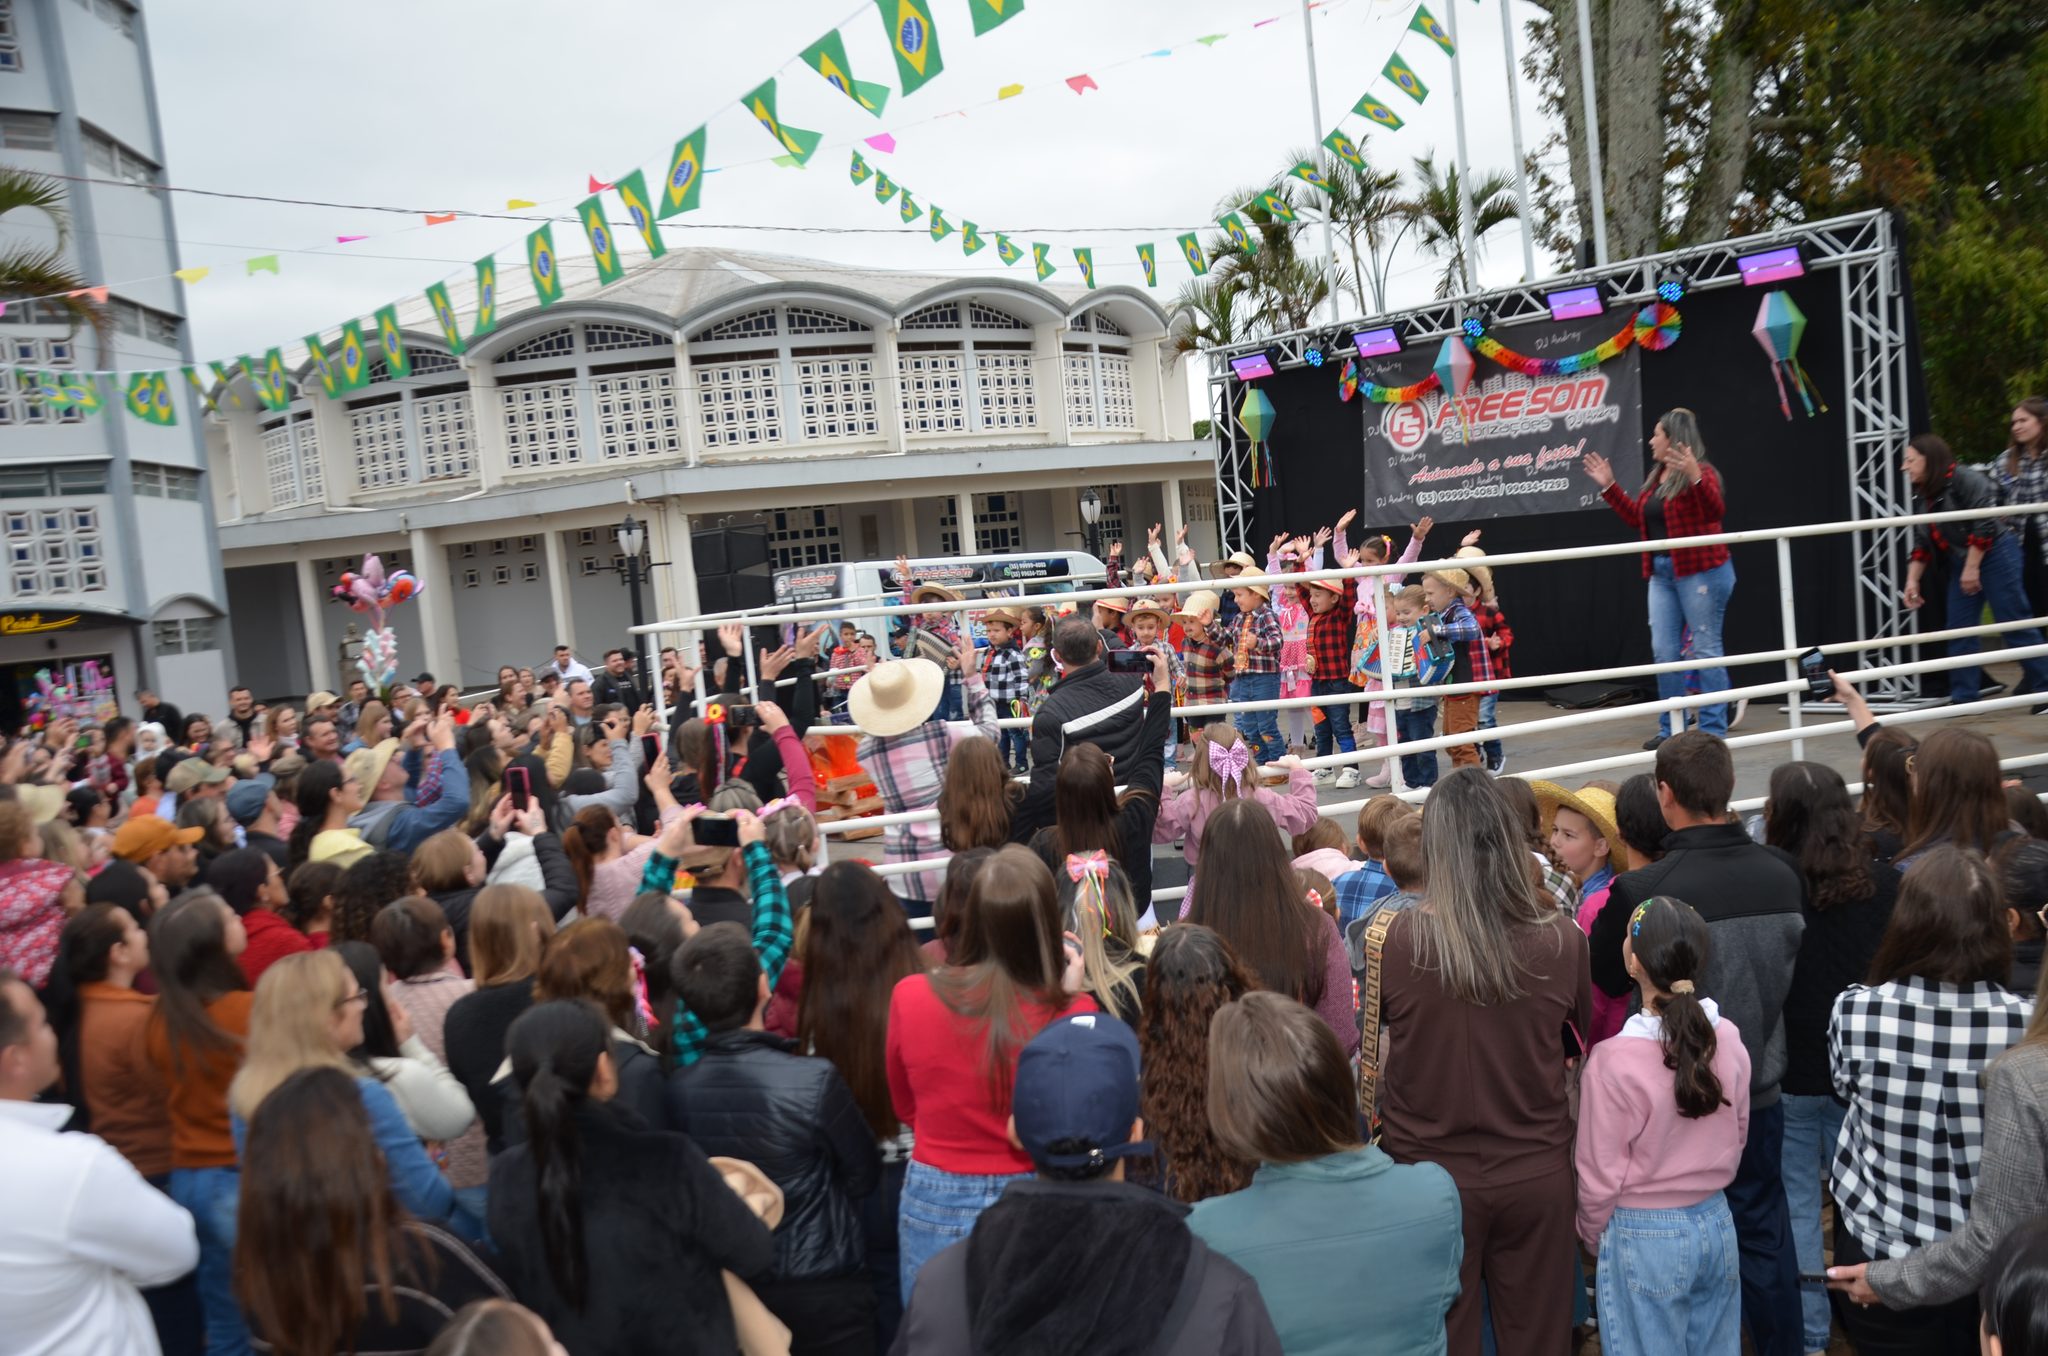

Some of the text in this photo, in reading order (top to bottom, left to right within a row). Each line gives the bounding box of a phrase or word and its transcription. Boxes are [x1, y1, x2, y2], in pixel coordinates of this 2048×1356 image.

[1535, 330, 1582, 350] DJ Andrey
[1377, 361, 1402, 374] Andrey
[1436, 378, 1606, 428] FREE SOM
[1367, 426, 1380, 437] DJ
[1393, 406, 1421, 443] FS
[1388, 452, 1427, 468] DJ Andrey
[1408, 438, 1587, 486] Animando a sua festa!
[1461, 474, 1504, 490] DJ Andrey
[1376, 492, 1414, 508] DJ Andrey
[1416, 490, 1438, 506] (55)
[1580, 494, 1594, 507] DJ
